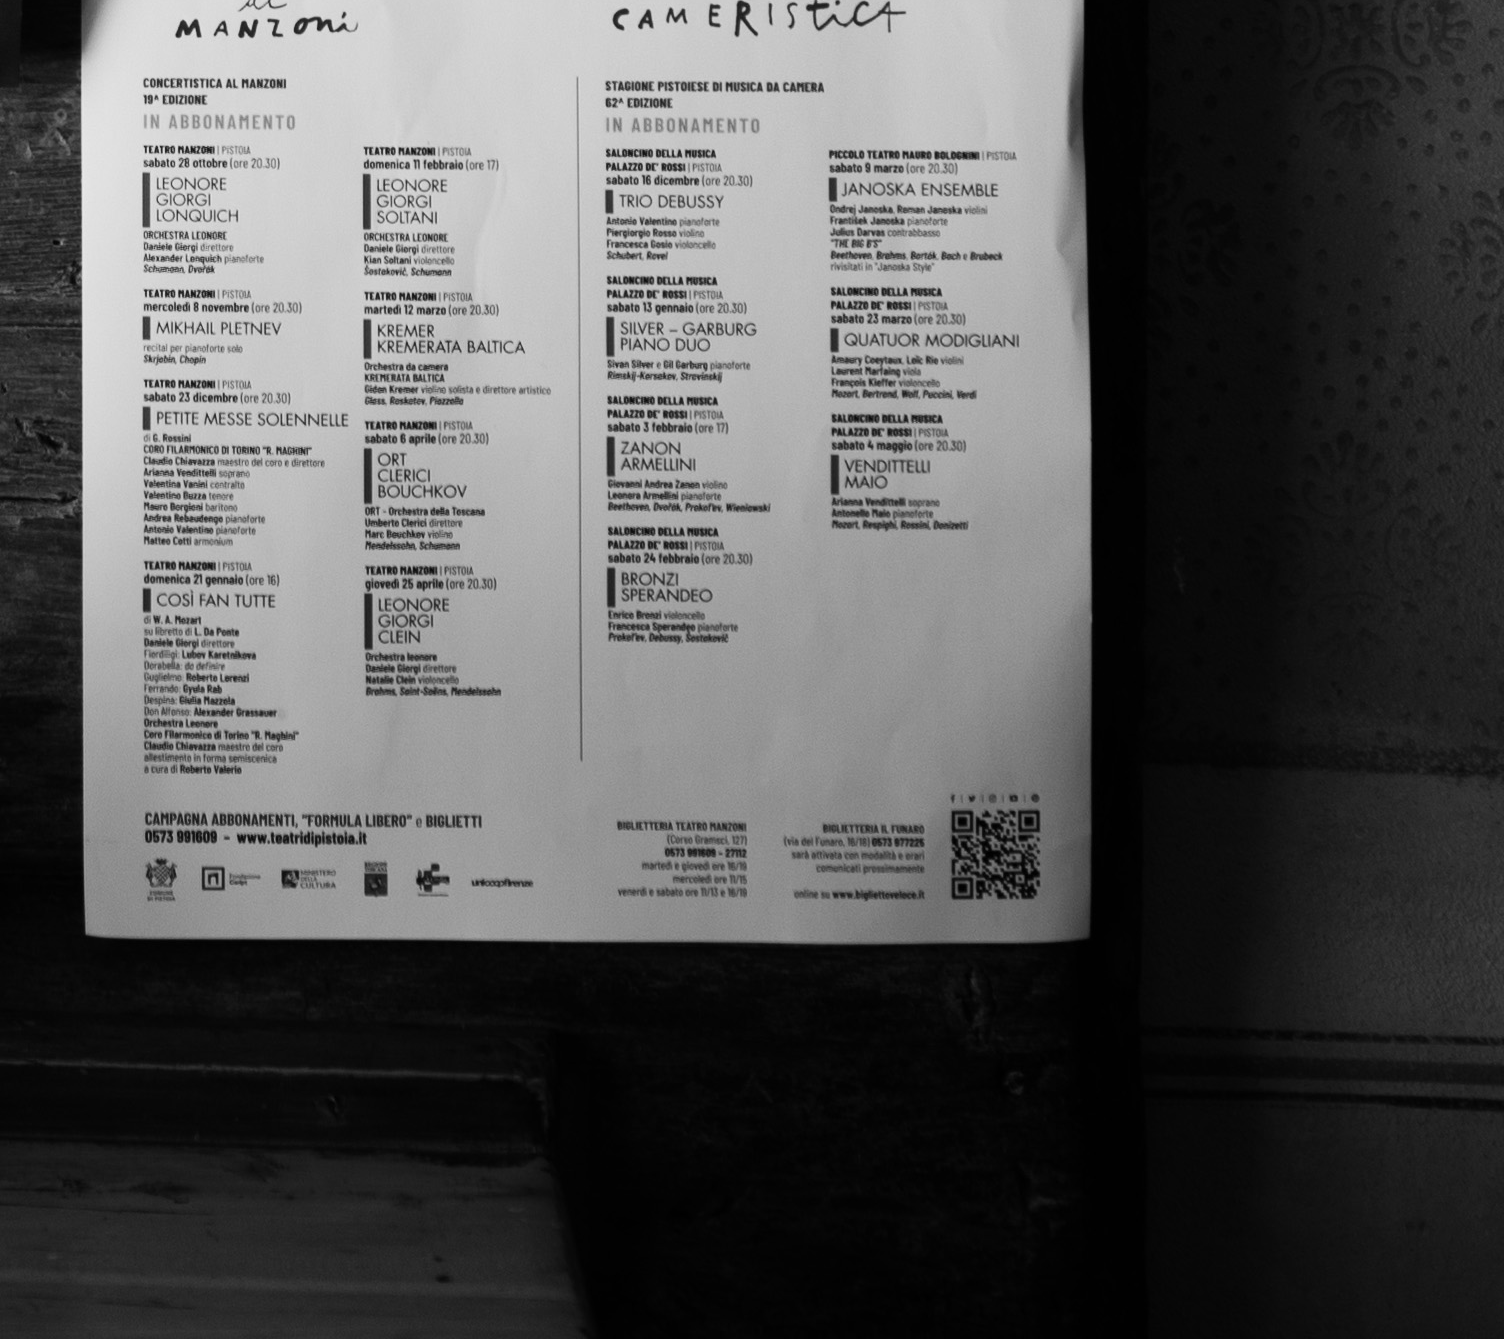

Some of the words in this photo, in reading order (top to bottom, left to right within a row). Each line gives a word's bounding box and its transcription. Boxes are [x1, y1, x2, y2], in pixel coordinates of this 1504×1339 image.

[143, 77, 223, 89] CONCERTISTICA
[225, 78, 238, 89] AL
[241, 78, 287, 89] MANZONI
[605, 80, 655, 92] STAGIONE
[657, 81, 709, 92] PISTOIESE
[712, 81, 723, 92] DI
[725, 81, 764, 93] MUSICA
[766, 81, 780, 93] DA
[782, 81, 825, 93] CAMERA
[156, 176, 227, 191] LEONORE
[841, 181, 916, 197] JANOSKA
[921, 182, 999, 198] ENSEMBLE
[155, 192, 211, 207] GIORGI
[619, 193, 653, 209] TRIO
[658, 194, 724, 209] DEBUSSY
[156, 208, 239, 223] LONQUICH
[156, 321, 216, 336] MIKHAIL
[220, 321, 282, 336] PLETNEV
[844, 332, 920, 348] QUATUOR
[924, 333, 1020, 348] MODIGLIANI
[156, 411, 199, 426] PETITE
[203, 411, 252, 427] MESSE
[257, 412, 349, 428] SOLENNELLE
